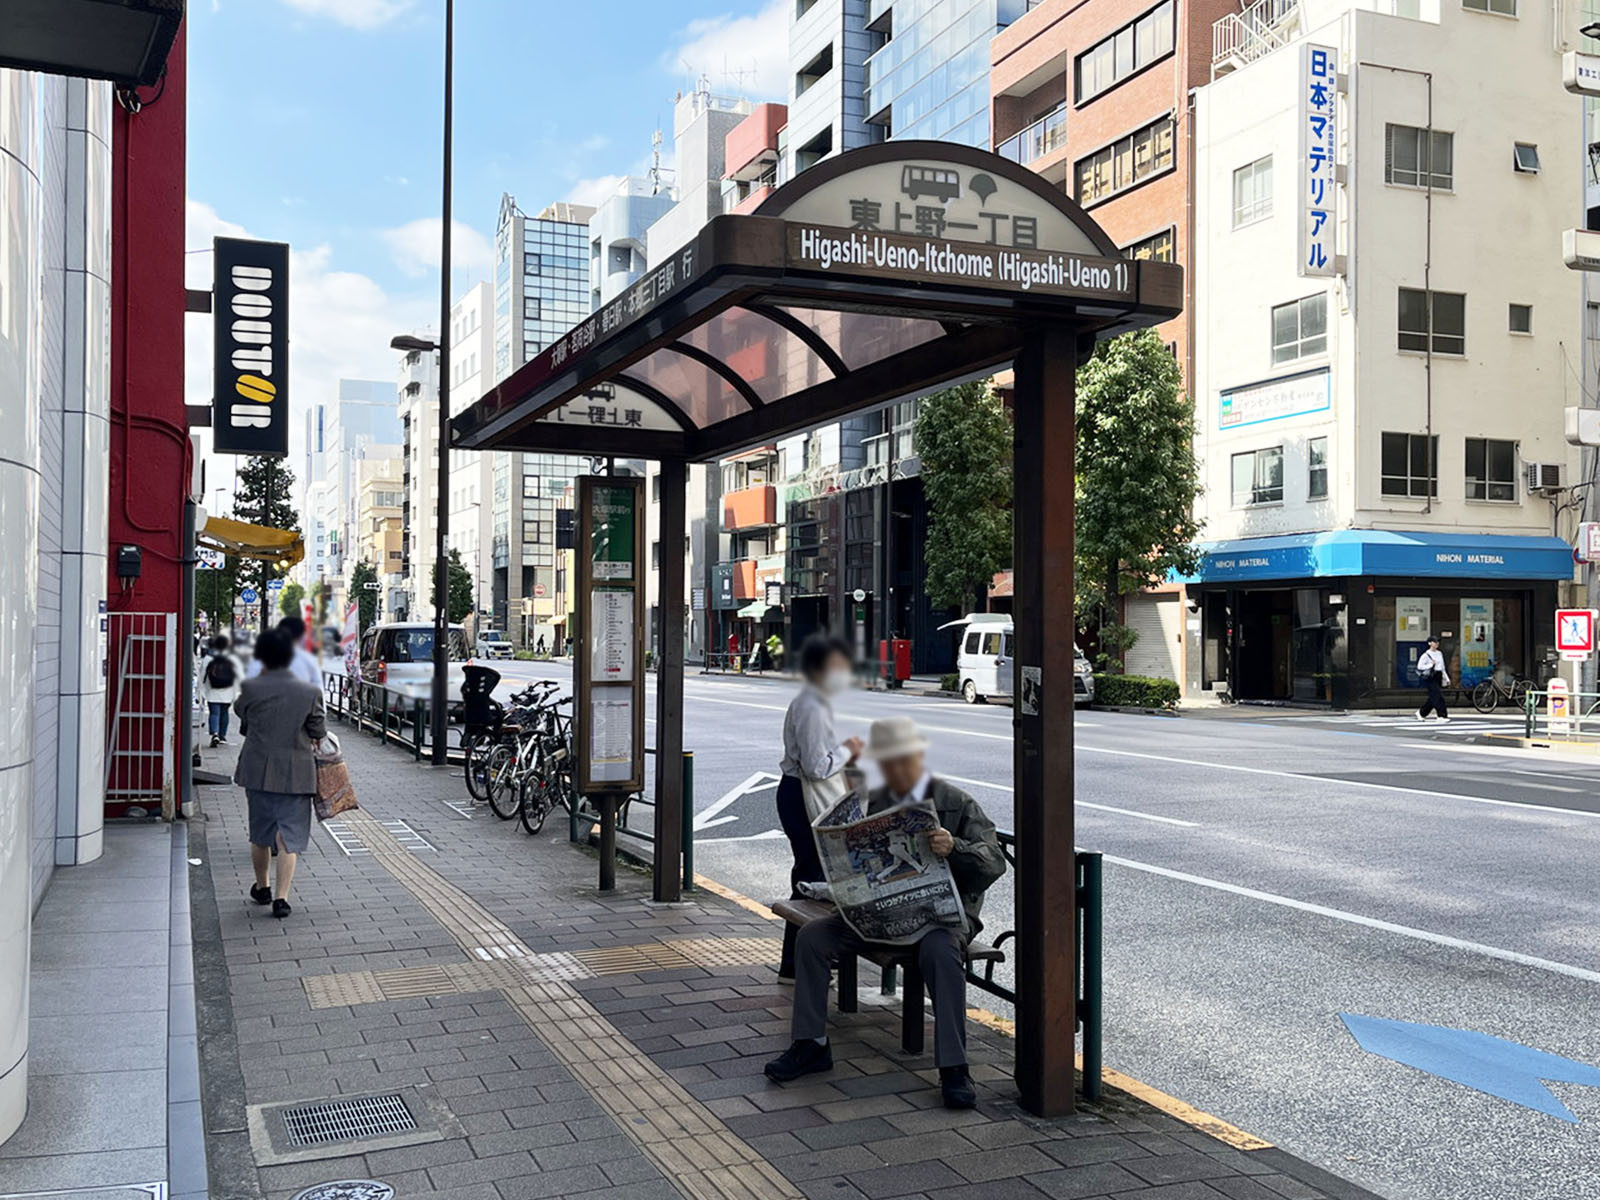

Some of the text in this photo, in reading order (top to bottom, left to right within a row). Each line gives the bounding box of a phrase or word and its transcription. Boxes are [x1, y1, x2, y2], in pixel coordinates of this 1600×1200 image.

[1308, 50, 1328, 269] 日本マテリアル
[849, 199, 1038, 250] 東上野一丁目
[682, 248, 693, 281] 行
[800, 229, 1129, 292] Higashi-Ueno-Itchome (Higashi-Ueno 1)
[231, 265, 277, 430] DOUTOR
[1215, 556, 1270, 569] NIHON MATERIAL
[1436, 553, 1504, 565] NIHON MATERIAL
